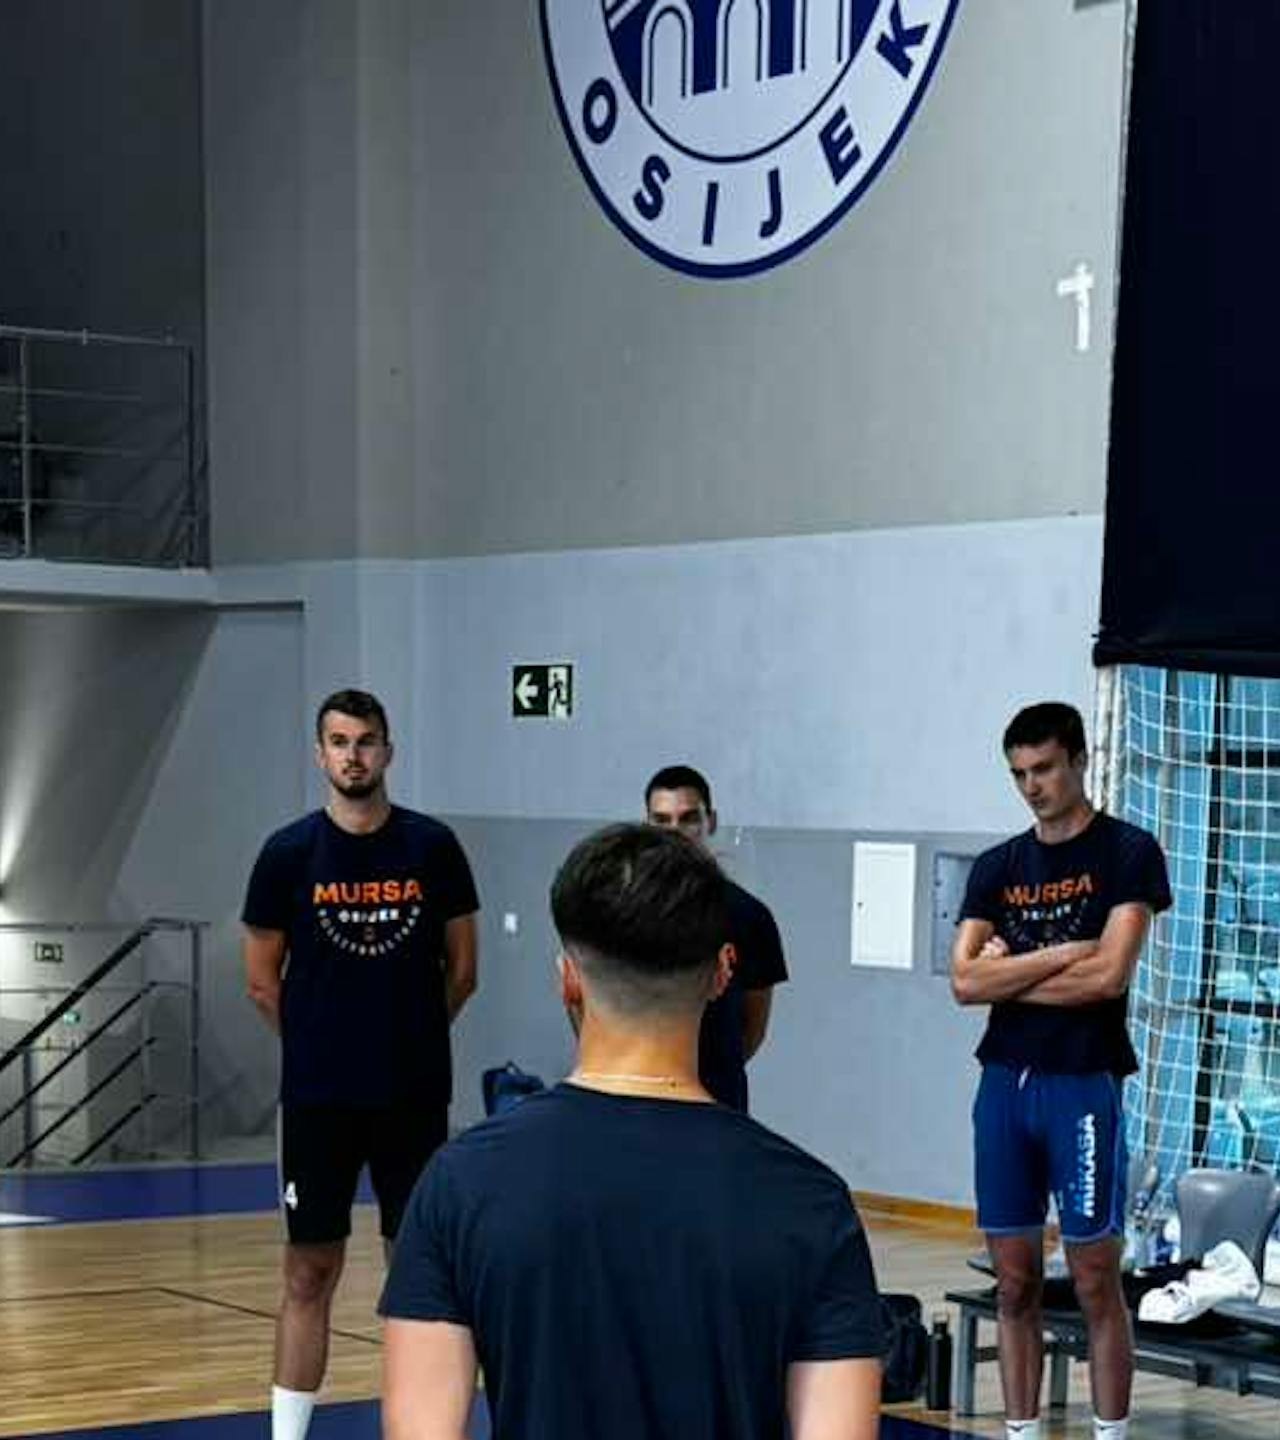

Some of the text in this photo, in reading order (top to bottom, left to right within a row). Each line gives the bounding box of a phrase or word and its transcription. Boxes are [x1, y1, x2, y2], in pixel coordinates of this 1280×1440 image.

[582, 0, 929, 246] OSIJEK
[313, 879, 424, 904] MURSA
[1003, 873, 1093, 906] MURSA
